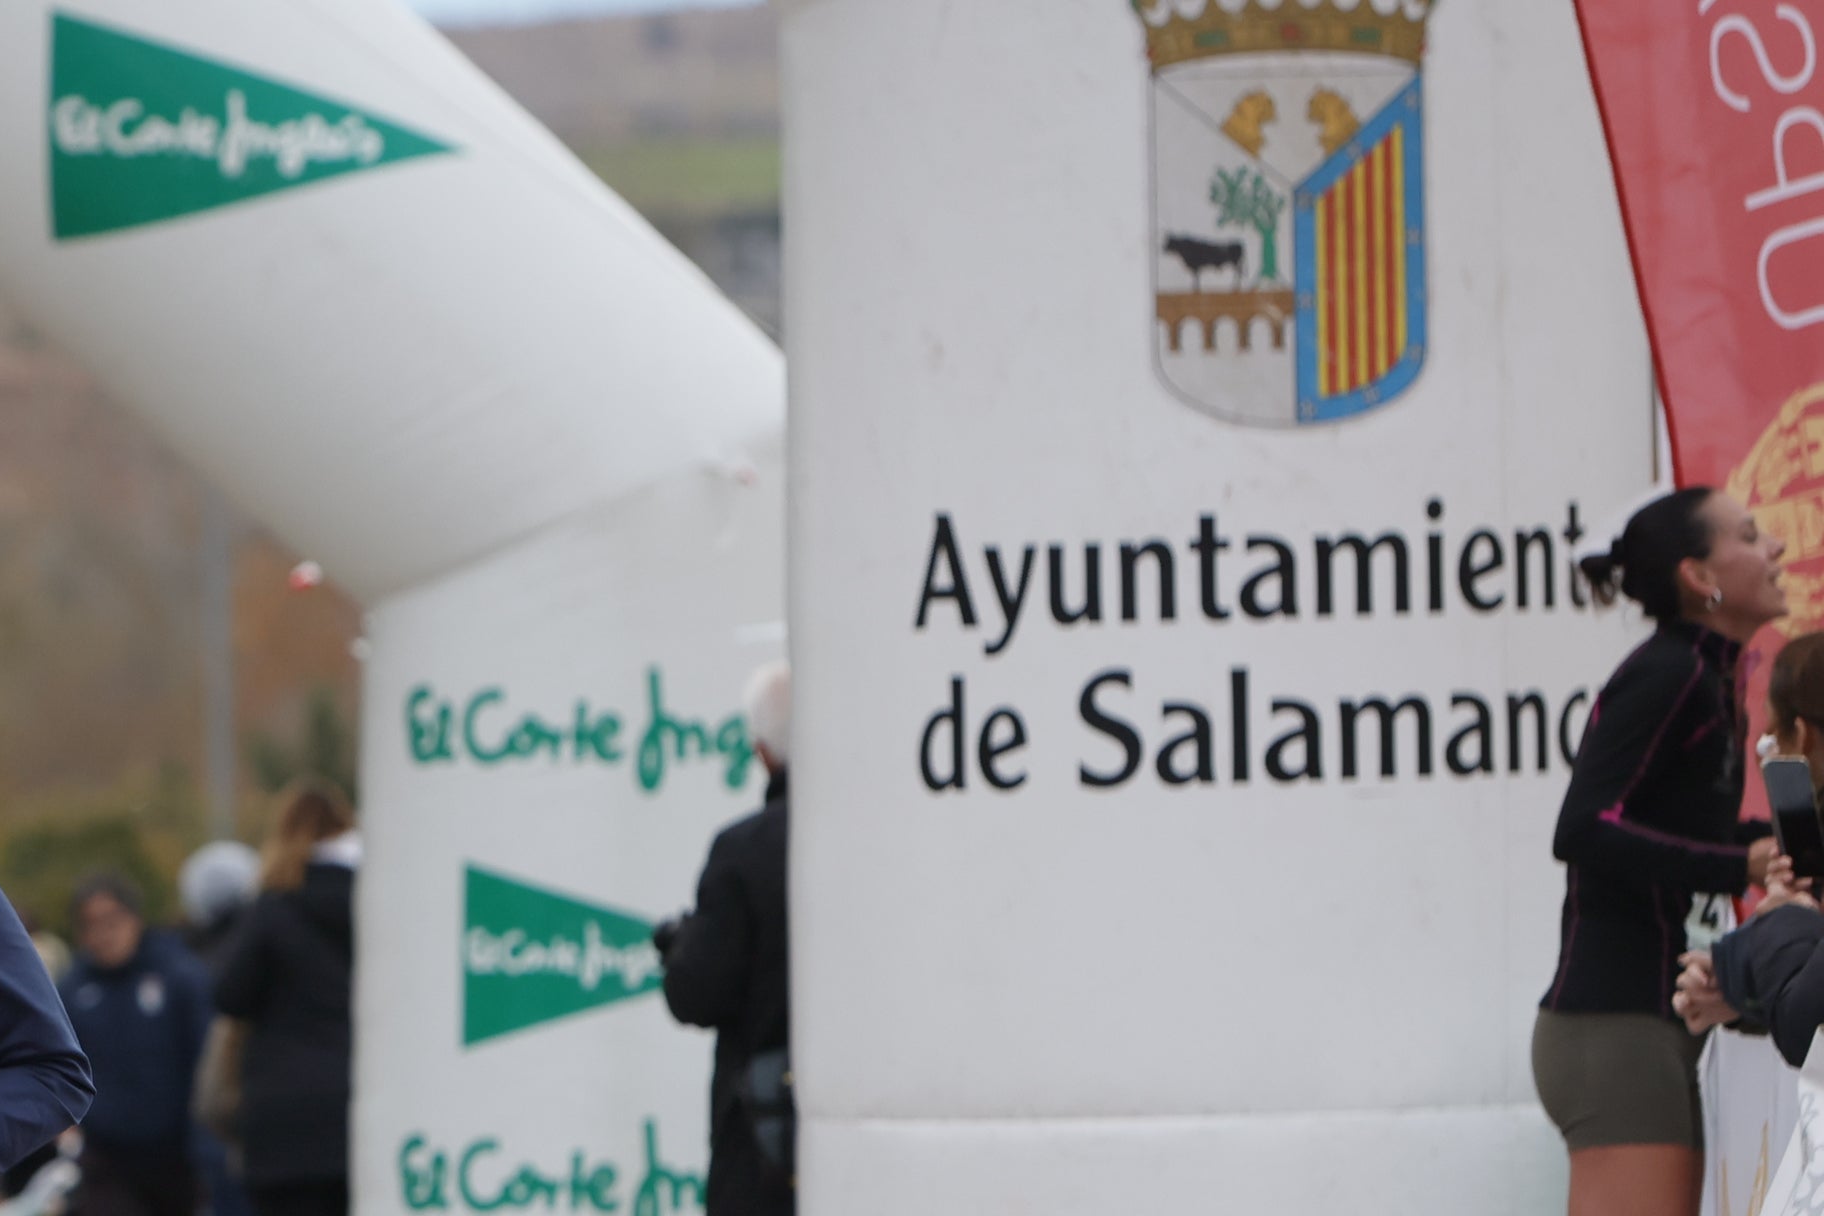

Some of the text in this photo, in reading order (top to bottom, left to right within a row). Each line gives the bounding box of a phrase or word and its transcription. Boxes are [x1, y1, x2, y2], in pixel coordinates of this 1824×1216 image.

[103, 97, 220, 158] Corte
[914, 497, 1585, 655] Ayuntamient
[406, 663, 754, 791] El Corte Ing
[919, 667, 1586, 790] de Salamanc
[398, 1132, 447, 1212] El
[458, 1138, 619, 1213] Corte
